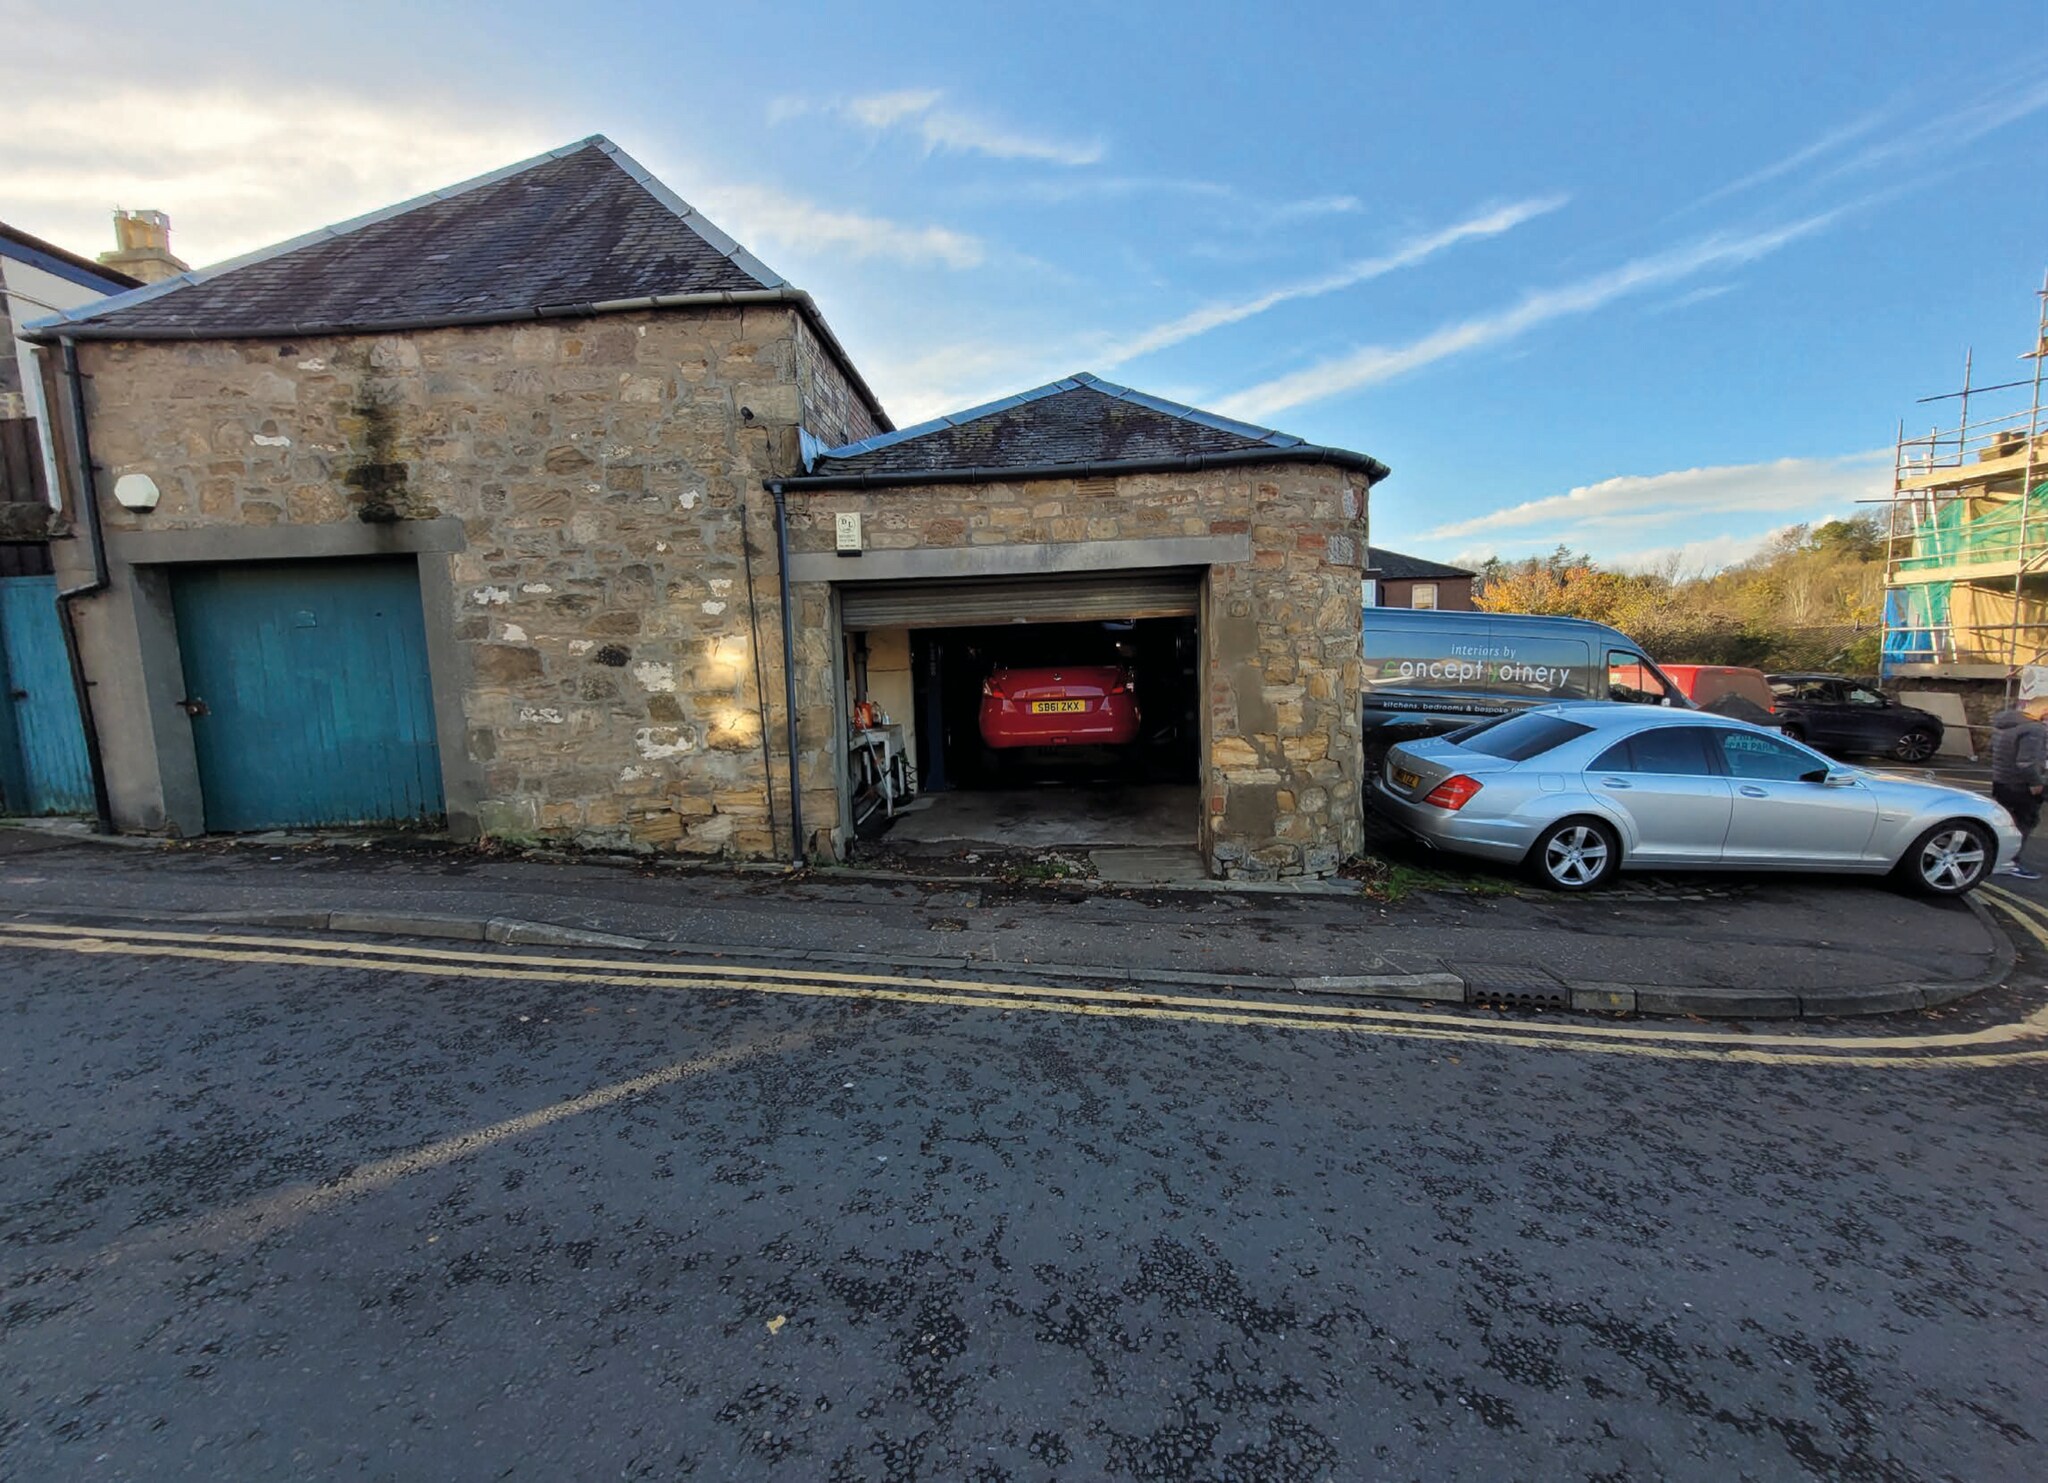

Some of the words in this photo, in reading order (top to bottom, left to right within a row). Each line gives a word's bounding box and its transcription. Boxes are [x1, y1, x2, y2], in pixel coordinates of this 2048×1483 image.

[1451, 644, 1500, 657] interiors
[1503, 645, 1517, 659] by
[1038, 703, 1059, 712] SB61
[1061, 702, 1079, 711] ZKX
[1423, 703, 1463, 712] bedrooms
[1474, 706, 1509, 715] bespoke
